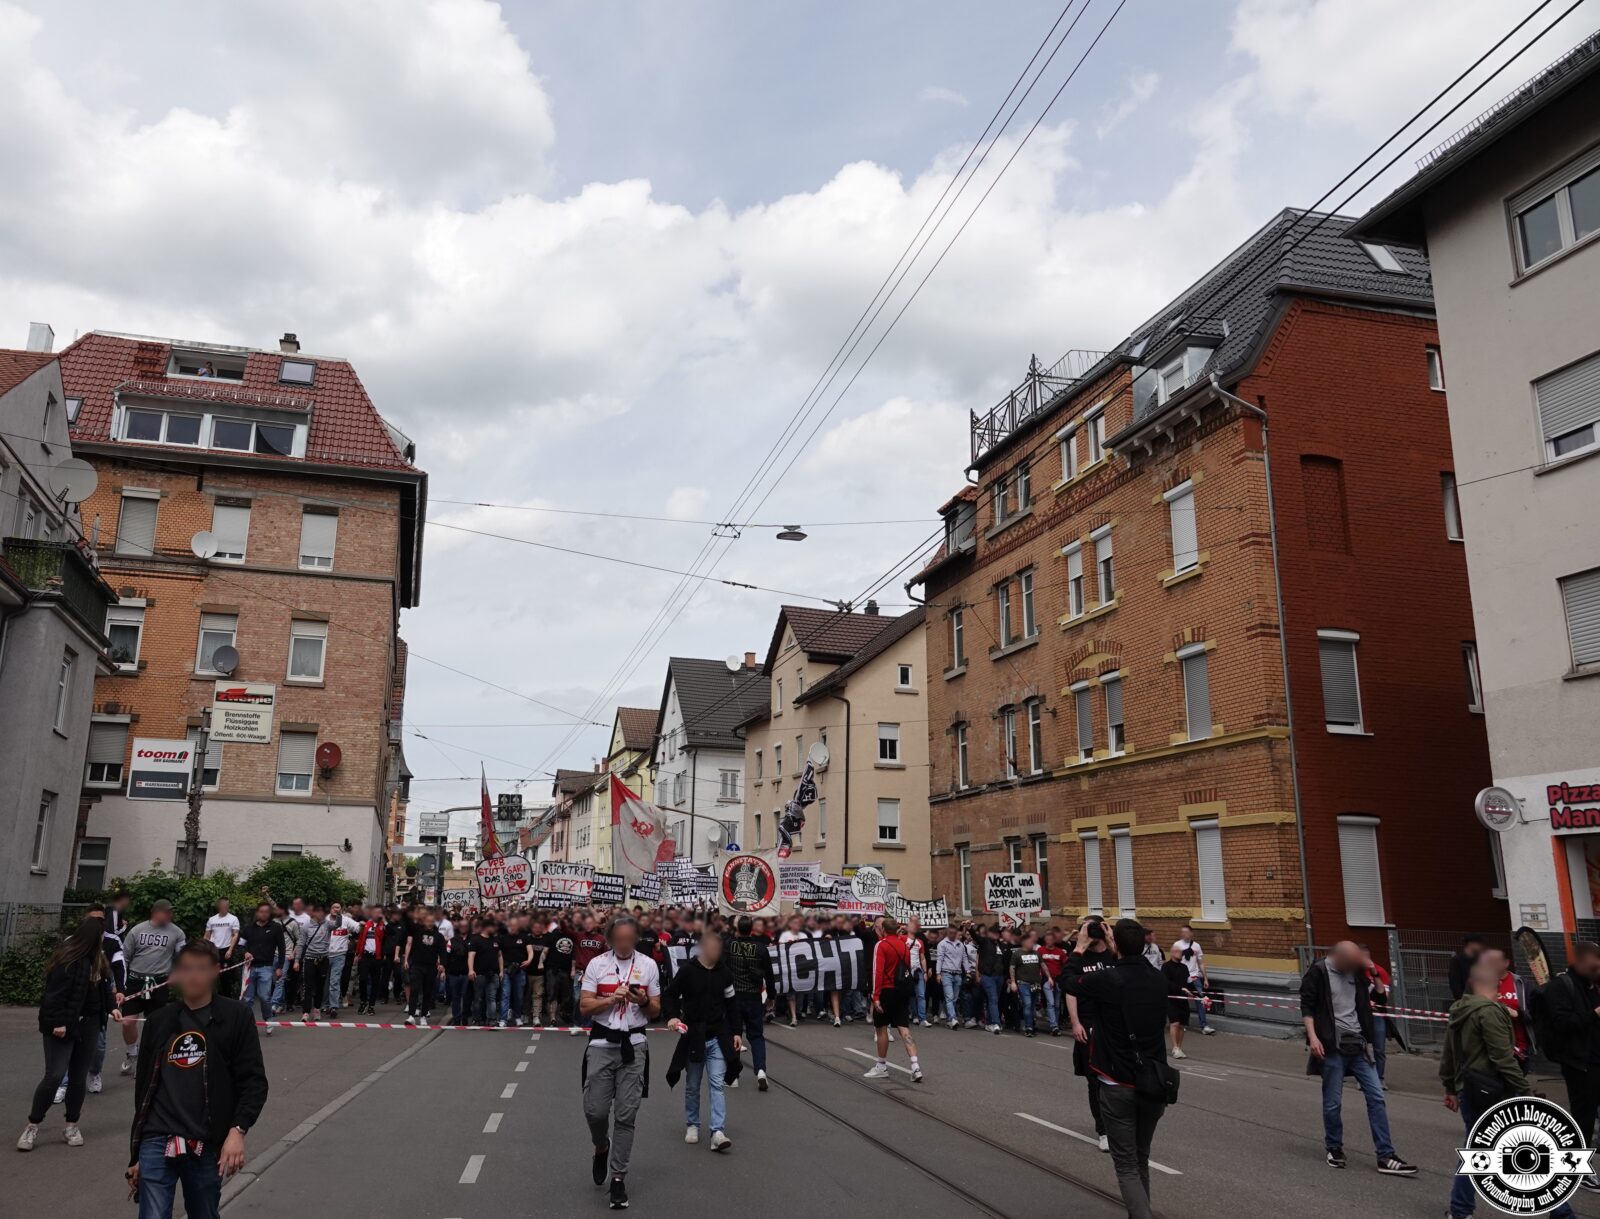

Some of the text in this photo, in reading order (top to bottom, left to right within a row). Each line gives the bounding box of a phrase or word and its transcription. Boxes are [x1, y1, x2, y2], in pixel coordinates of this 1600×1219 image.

[224, 711, 261, 719] Brennstoffe
[225, 718, 259, 726] Flüssiggas
[223, 724, 259, 732] Holzkohlen
[137, 748, 178, 759] toom
[1546, 781, 1600, 806] Pizza
[1550, 806, 1600, 830] Man
[477, 863, 528, 876] STUTTGART
[484, 873, 523, 883] DAS SIND
[643, 872, 657, 881] VOG
[988, 874, 1034, 888] VOGT und
[442, 891, 466, 901] VOGT
[591, 891, 623, 901] CHLANGE
[988, 888, 1022, 899] ADRION
[538, 899, 571, 908] KAPUTT
[896, 898, 945, 911] ULTRAS
[987, 900, 1008, 909] ZEIT
[896, 909, 945, 919] BEDEUTET
[139, 933, 169, 947] UCSD
